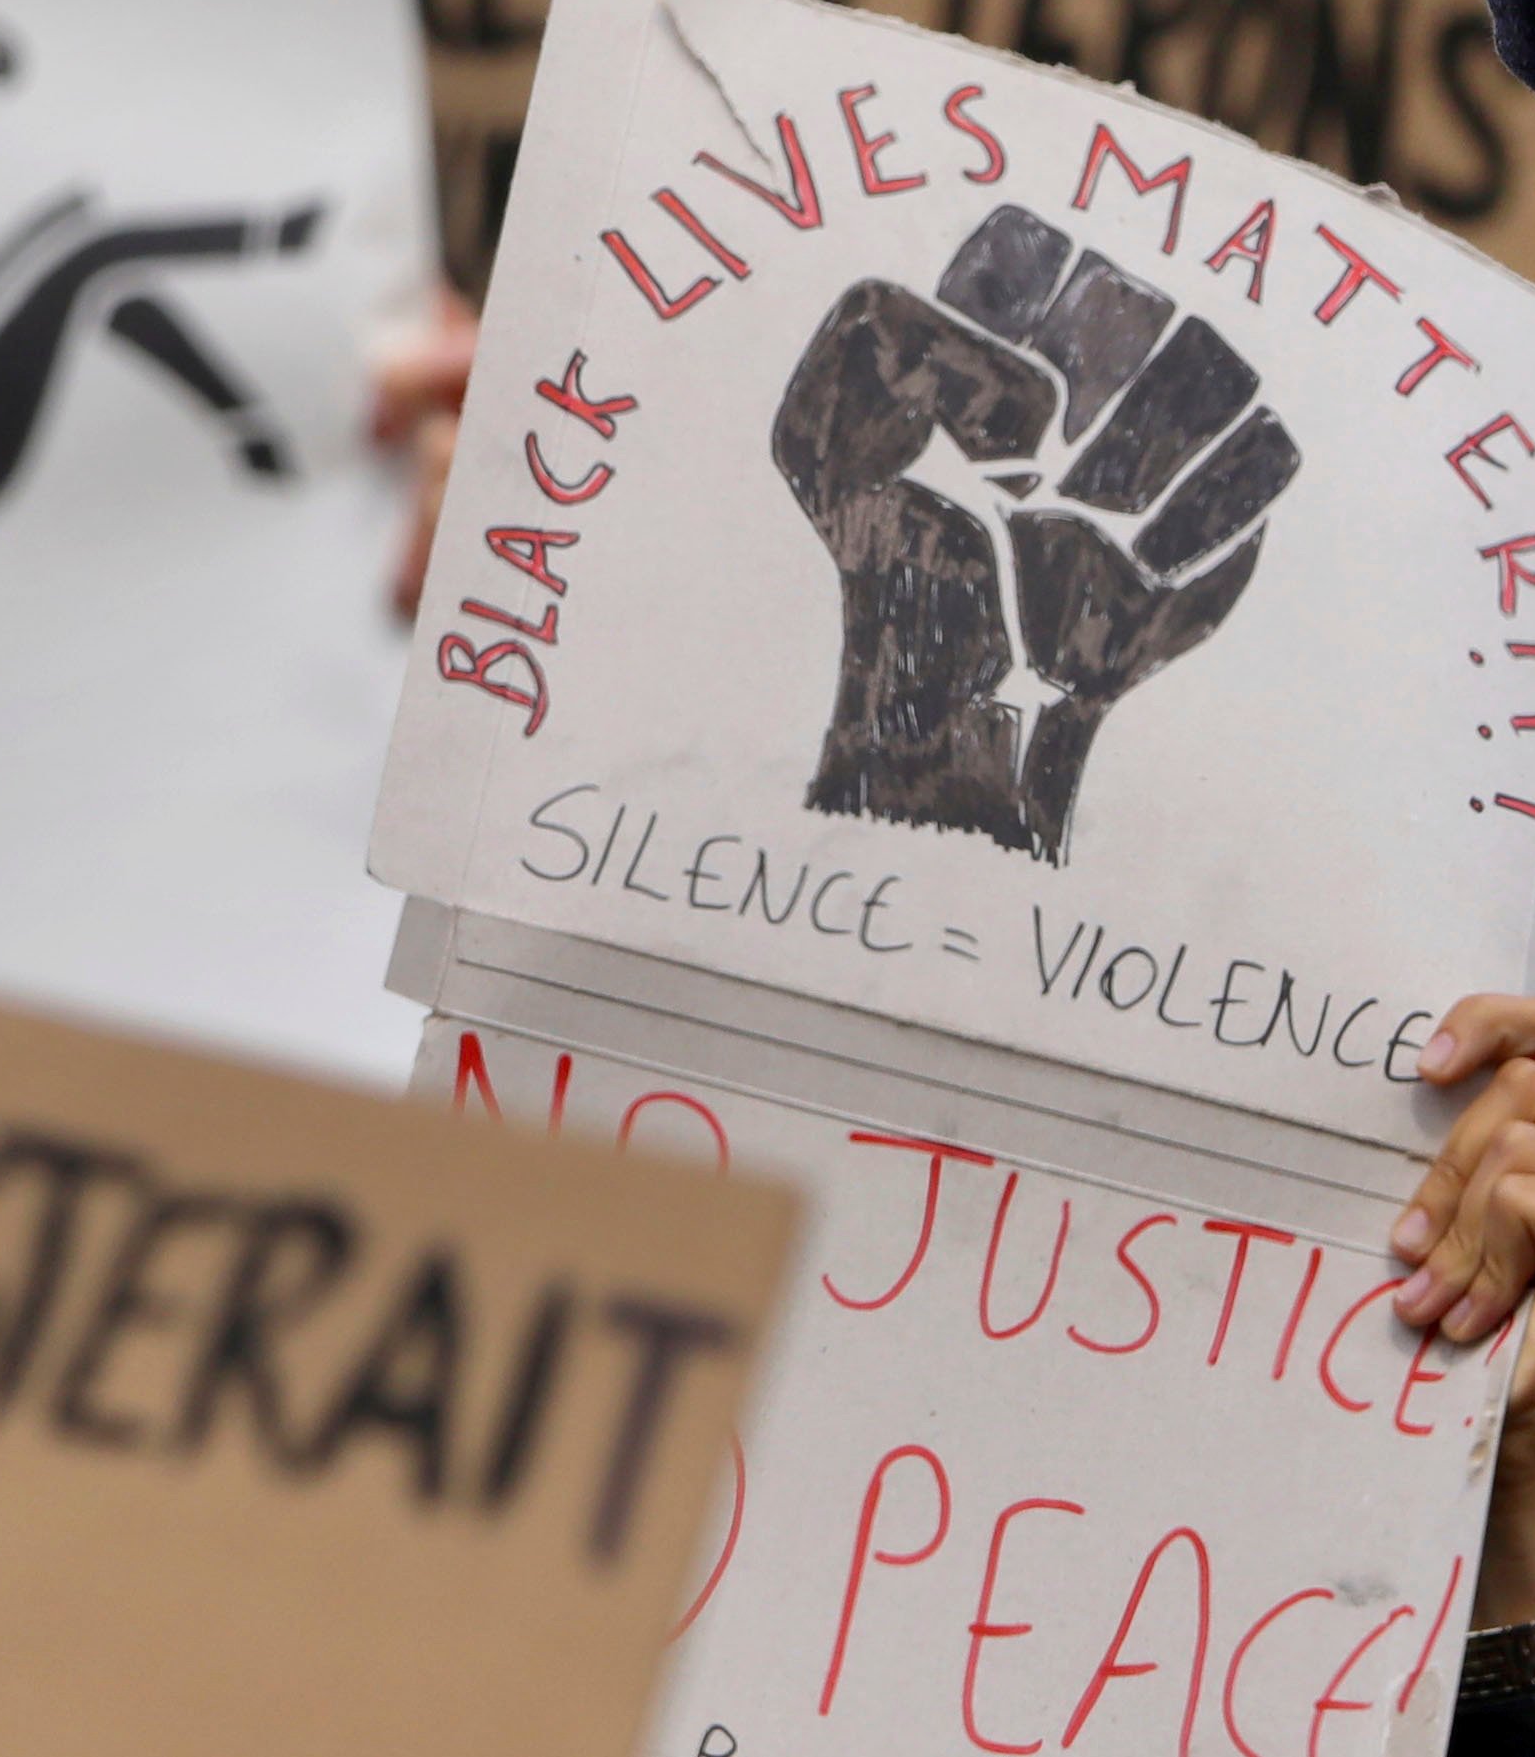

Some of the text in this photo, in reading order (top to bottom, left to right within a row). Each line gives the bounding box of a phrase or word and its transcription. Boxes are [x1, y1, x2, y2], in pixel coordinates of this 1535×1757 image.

[438, 349, 640, 738] BLACK
[598, 84, 1008, 322] LIVES
[520, 784, 916, 955] SILENCE
[1031, 904, 1434, 1086] VIOLENCE
